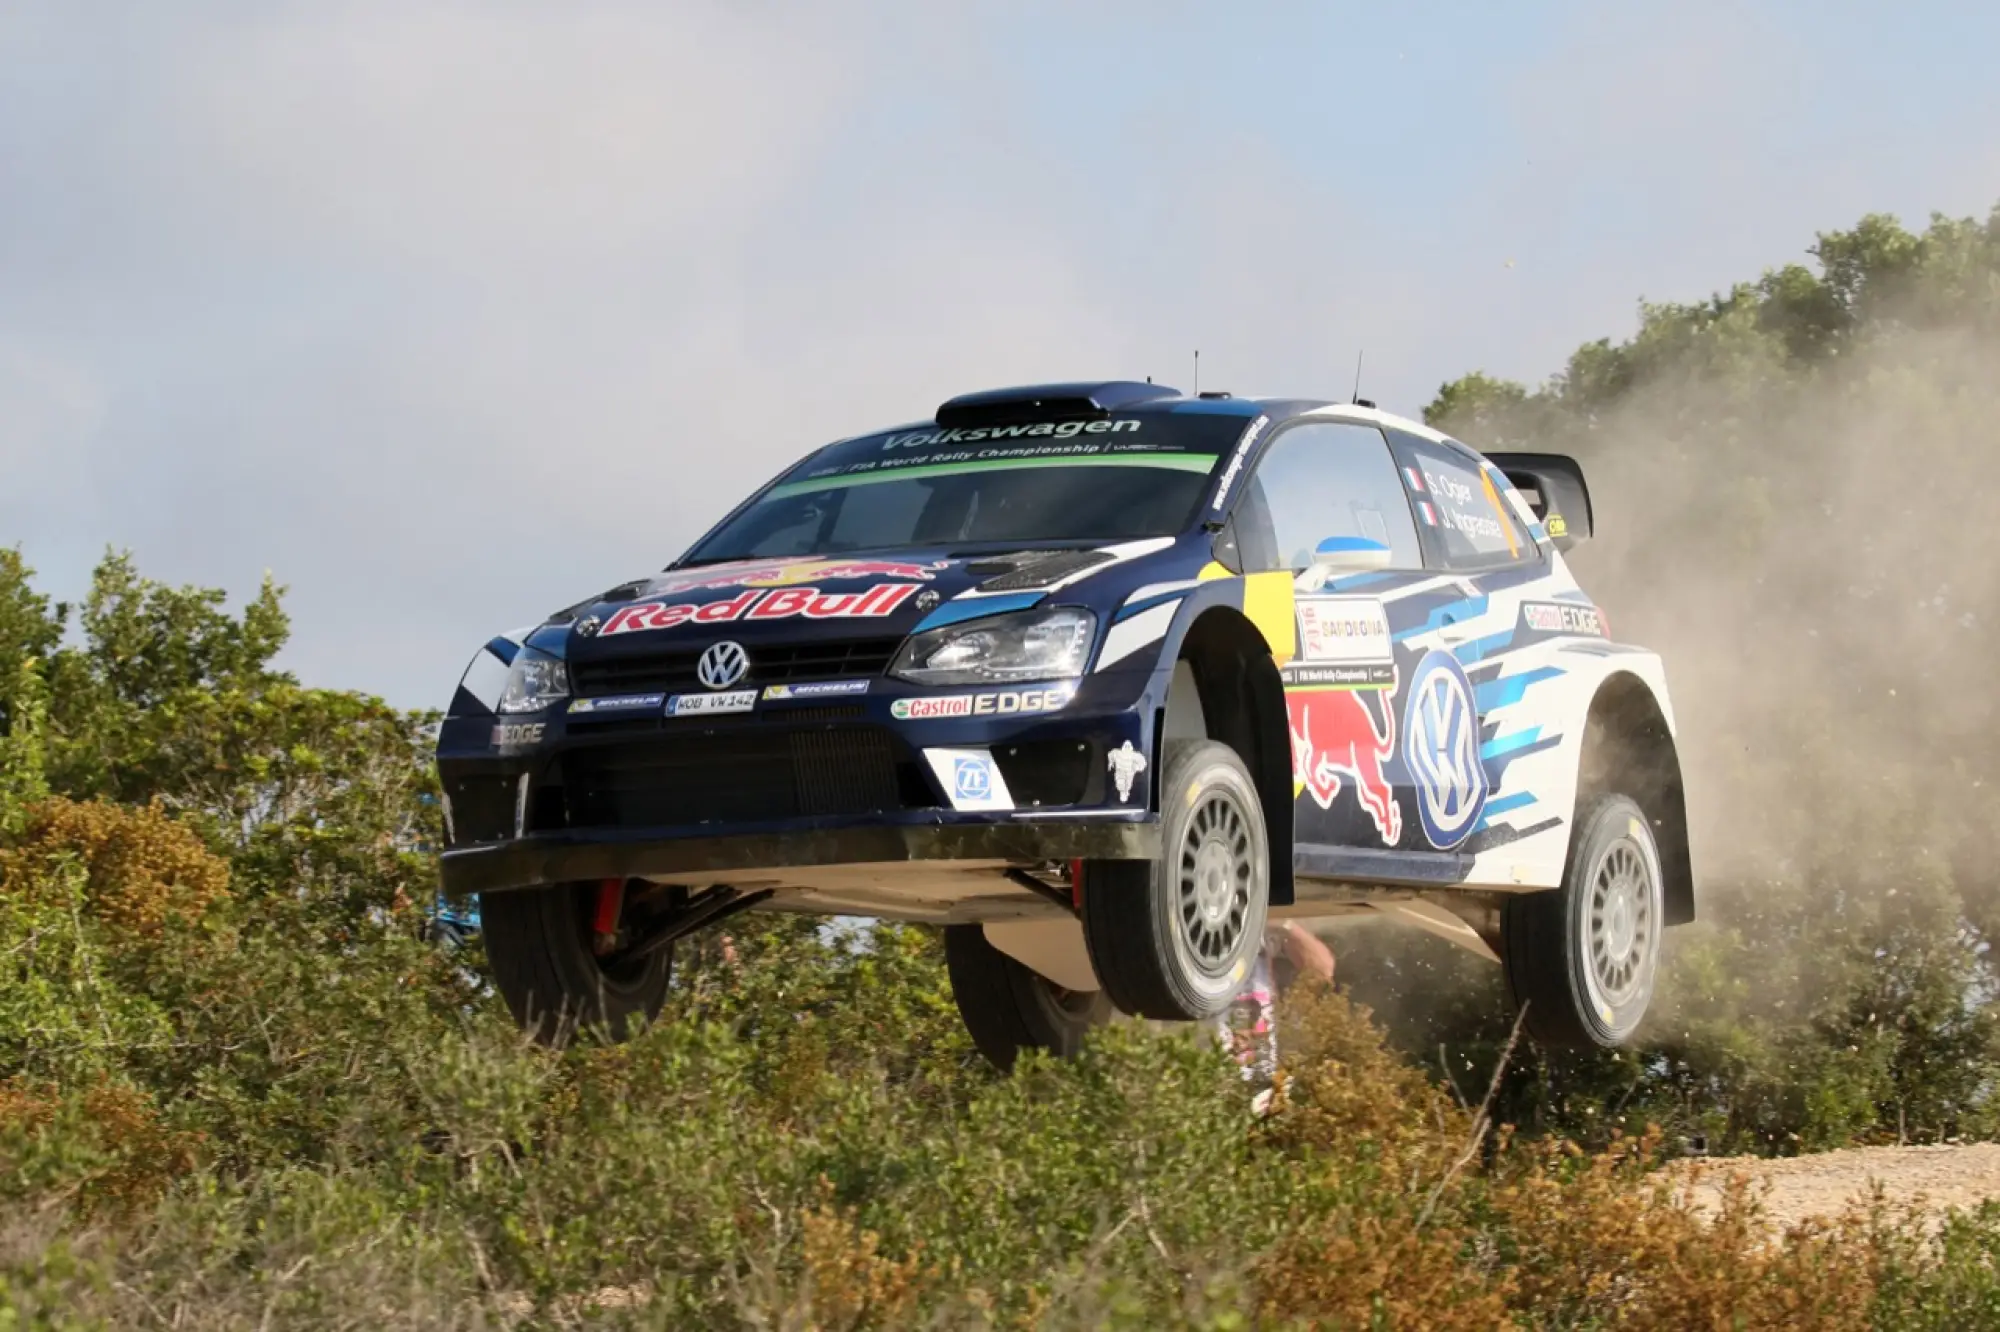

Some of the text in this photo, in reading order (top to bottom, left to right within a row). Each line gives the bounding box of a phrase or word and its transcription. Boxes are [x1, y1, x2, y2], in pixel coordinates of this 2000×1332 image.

[882, 418, 1141, 450] Volkswagen
[881, 455, 928, 468] World
[931, 450, 973, 463] Rally
[978, 444, 1100, 459] Championship
[1560, 605, 1601, 635] EDGE
[909, 691, 1060, 718] Castrol EDGE
[504, 722, 547, 743] EDGE
